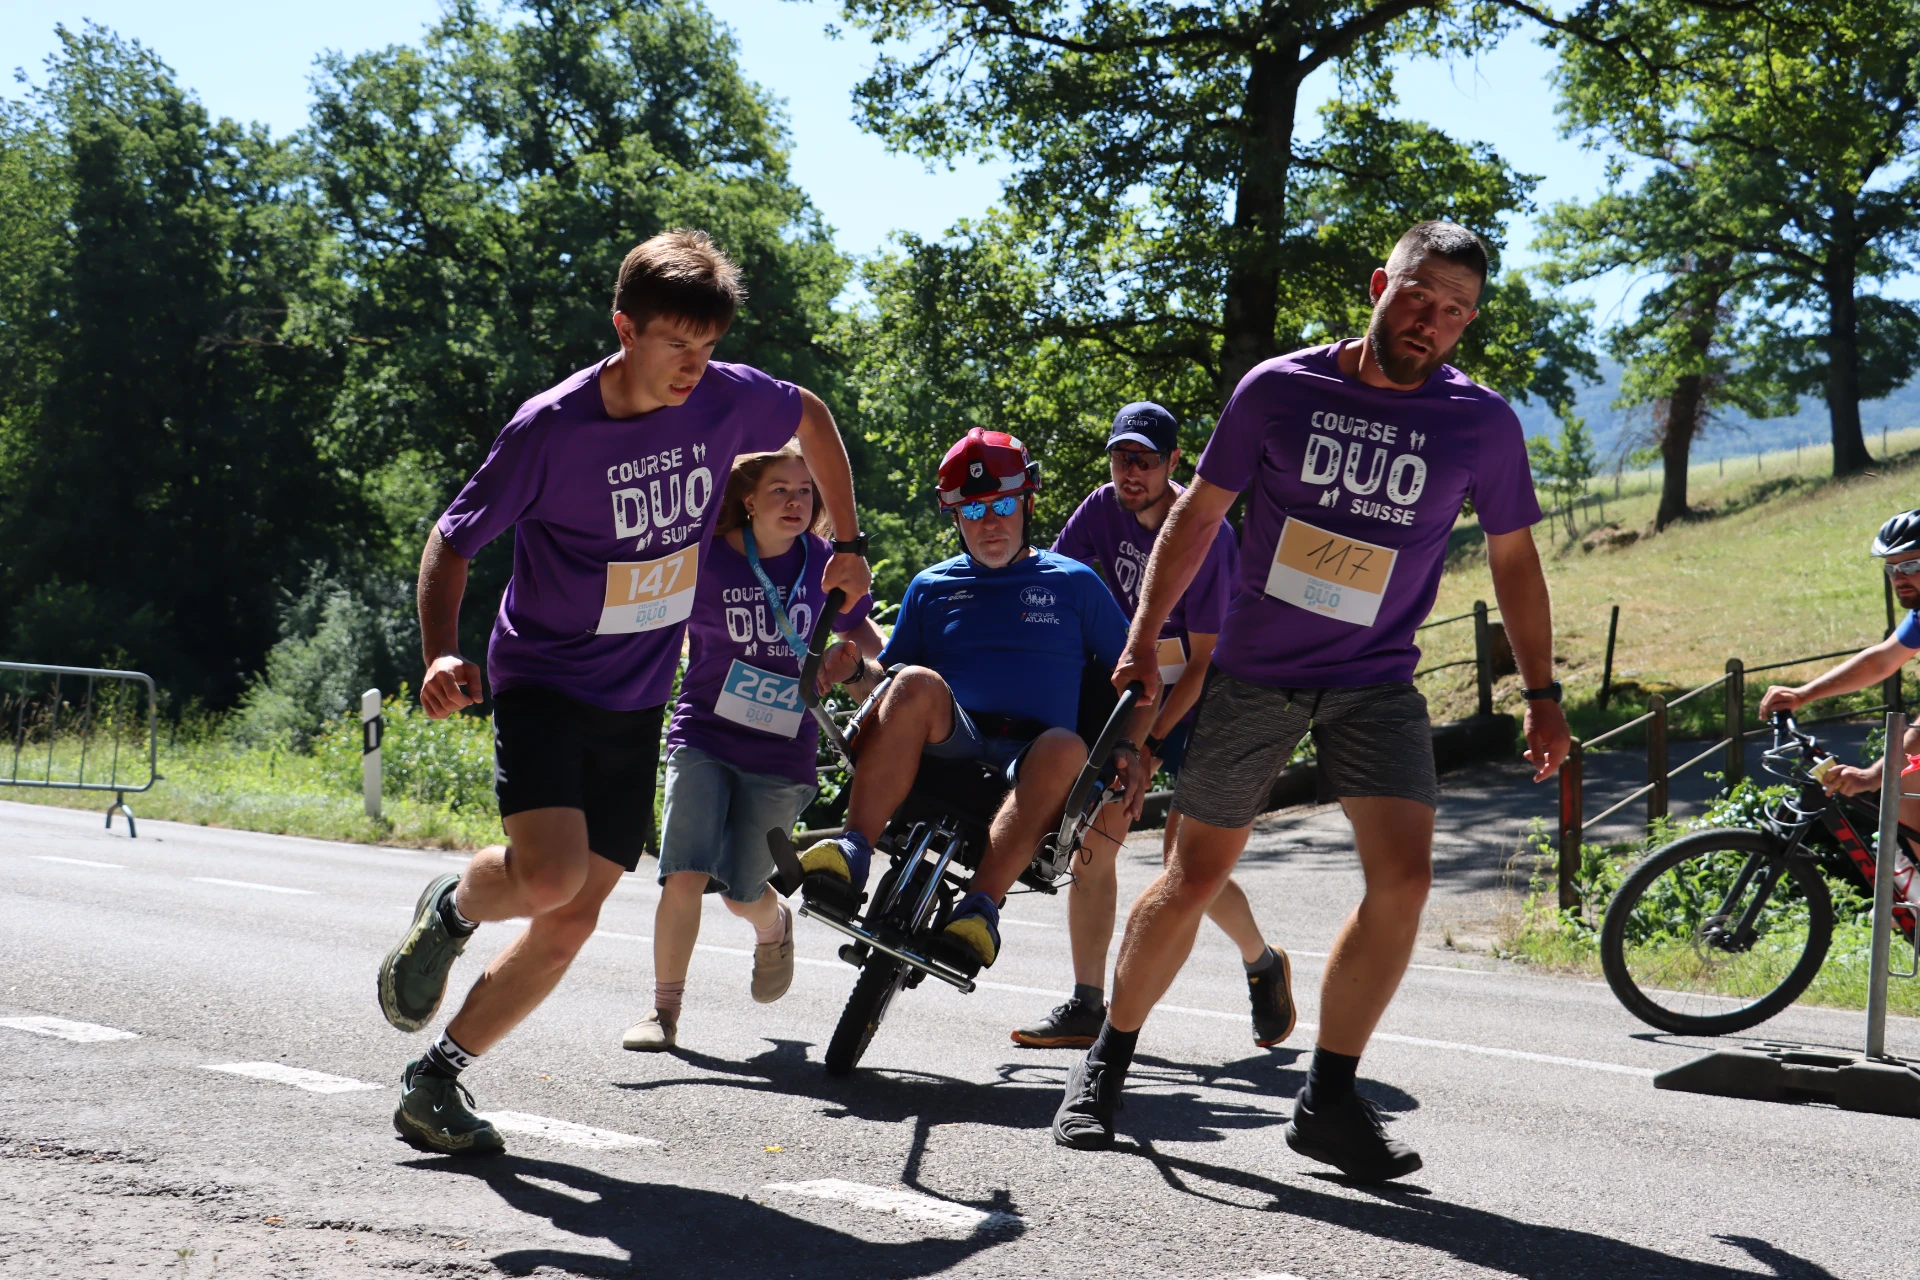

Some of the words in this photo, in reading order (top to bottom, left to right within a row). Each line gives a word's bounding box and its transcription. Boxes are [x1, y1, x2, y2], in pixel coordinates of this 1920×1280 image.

[1127, 419, 1149, 427] CRISP
[1311, 411, 1398, 445] COURSE
[607, 447, 683, 485] COURSE
[1300, 433, 1427, 506] DUO
[611, 466, 713, 540] DUO
[1350, 498, 1416, 526] SUISSE
[1306, 538, 1374, 581] 117
[627, 555, 684, 601] 147
[722, 585, 787, 603] COURE
[753, 563, 773, 591] COURSE
[769, 592, 780, 608] DUO
[1303, 584, 1341, 608] DUO
[636, 605, 667, 623] DUO
[725, 603, 812, 643] DUO
[1025, 616, 1060, 625] ATLANTIC
[767, 643, 808, 657] SUIS
[734, 669, 799, 710] 264
[745, 707, 774, 724] DUO
